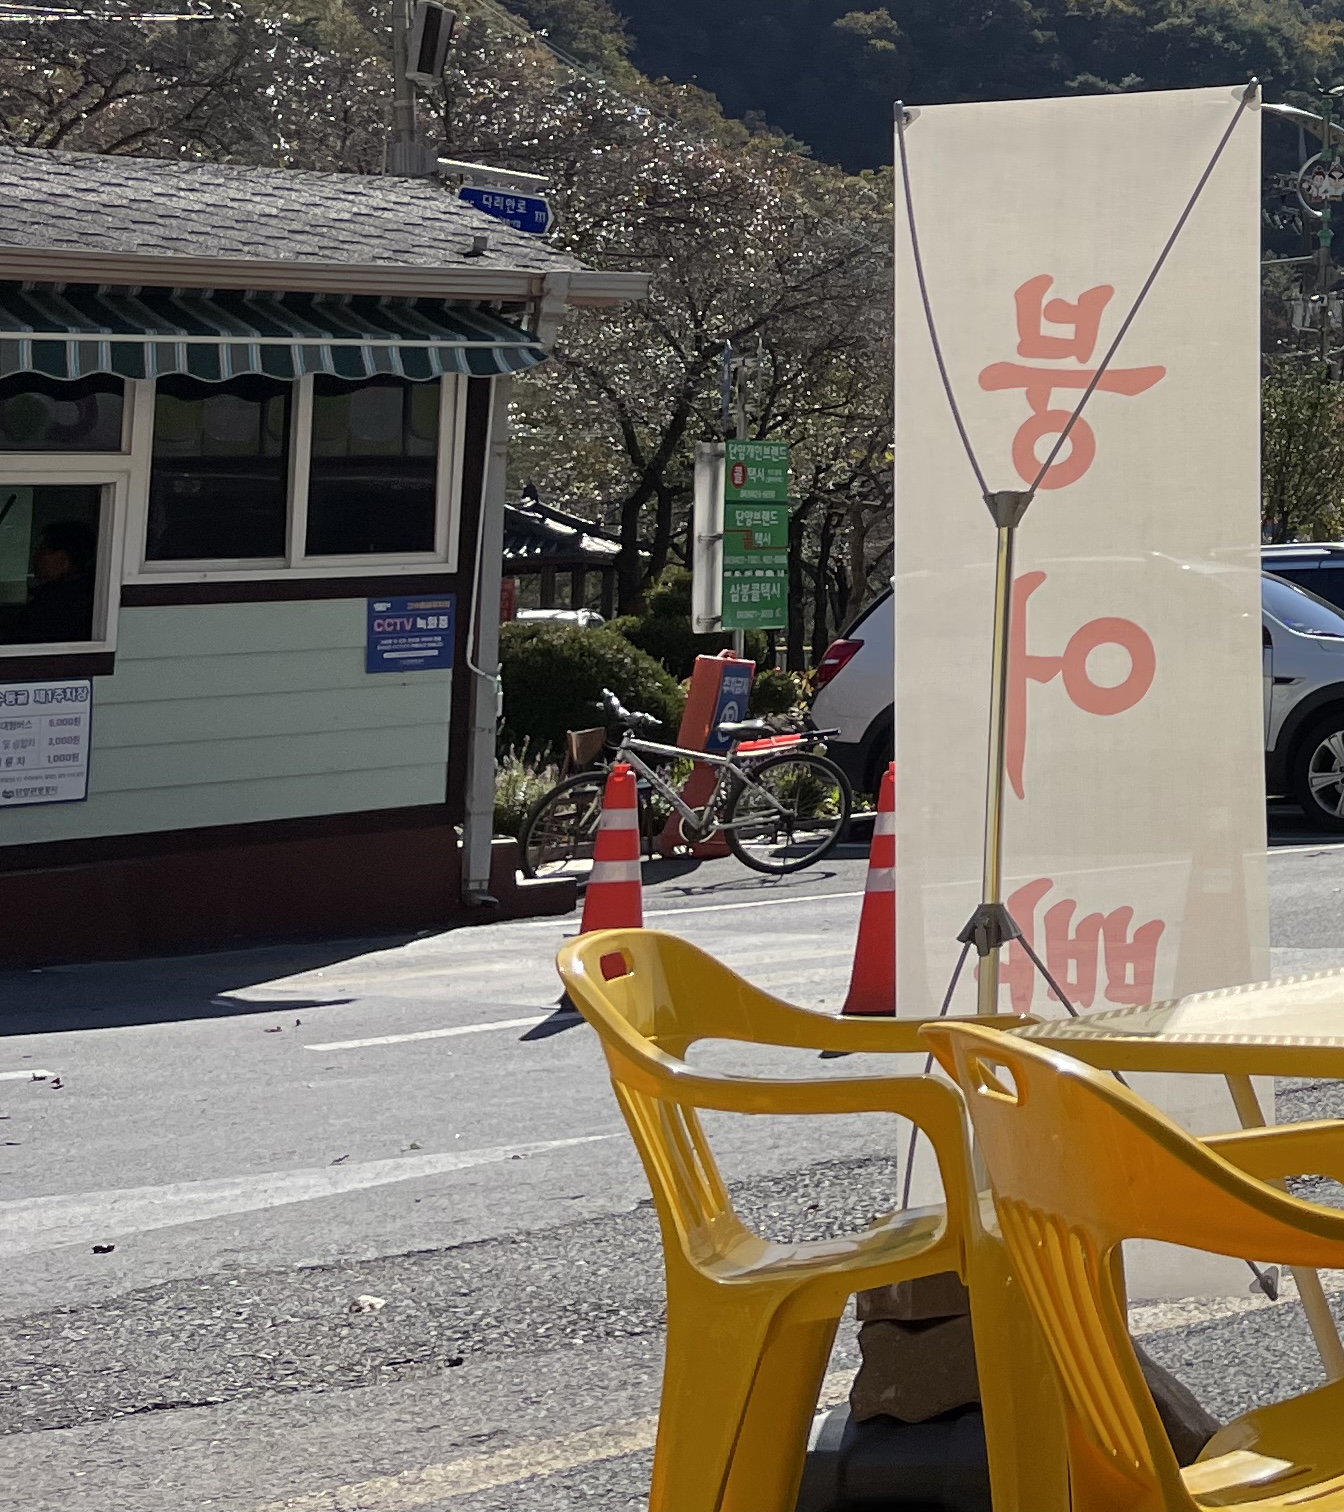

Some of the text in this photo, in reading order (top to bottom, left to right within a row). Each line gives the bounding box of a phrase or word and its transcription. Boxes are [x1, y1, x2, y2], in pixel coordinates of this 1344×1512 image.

[482, 194, 527, 214] 다리안로
[729, 582, 781, 602] 삼봉콜택시
[374, 617, 414, 632] CCTV
